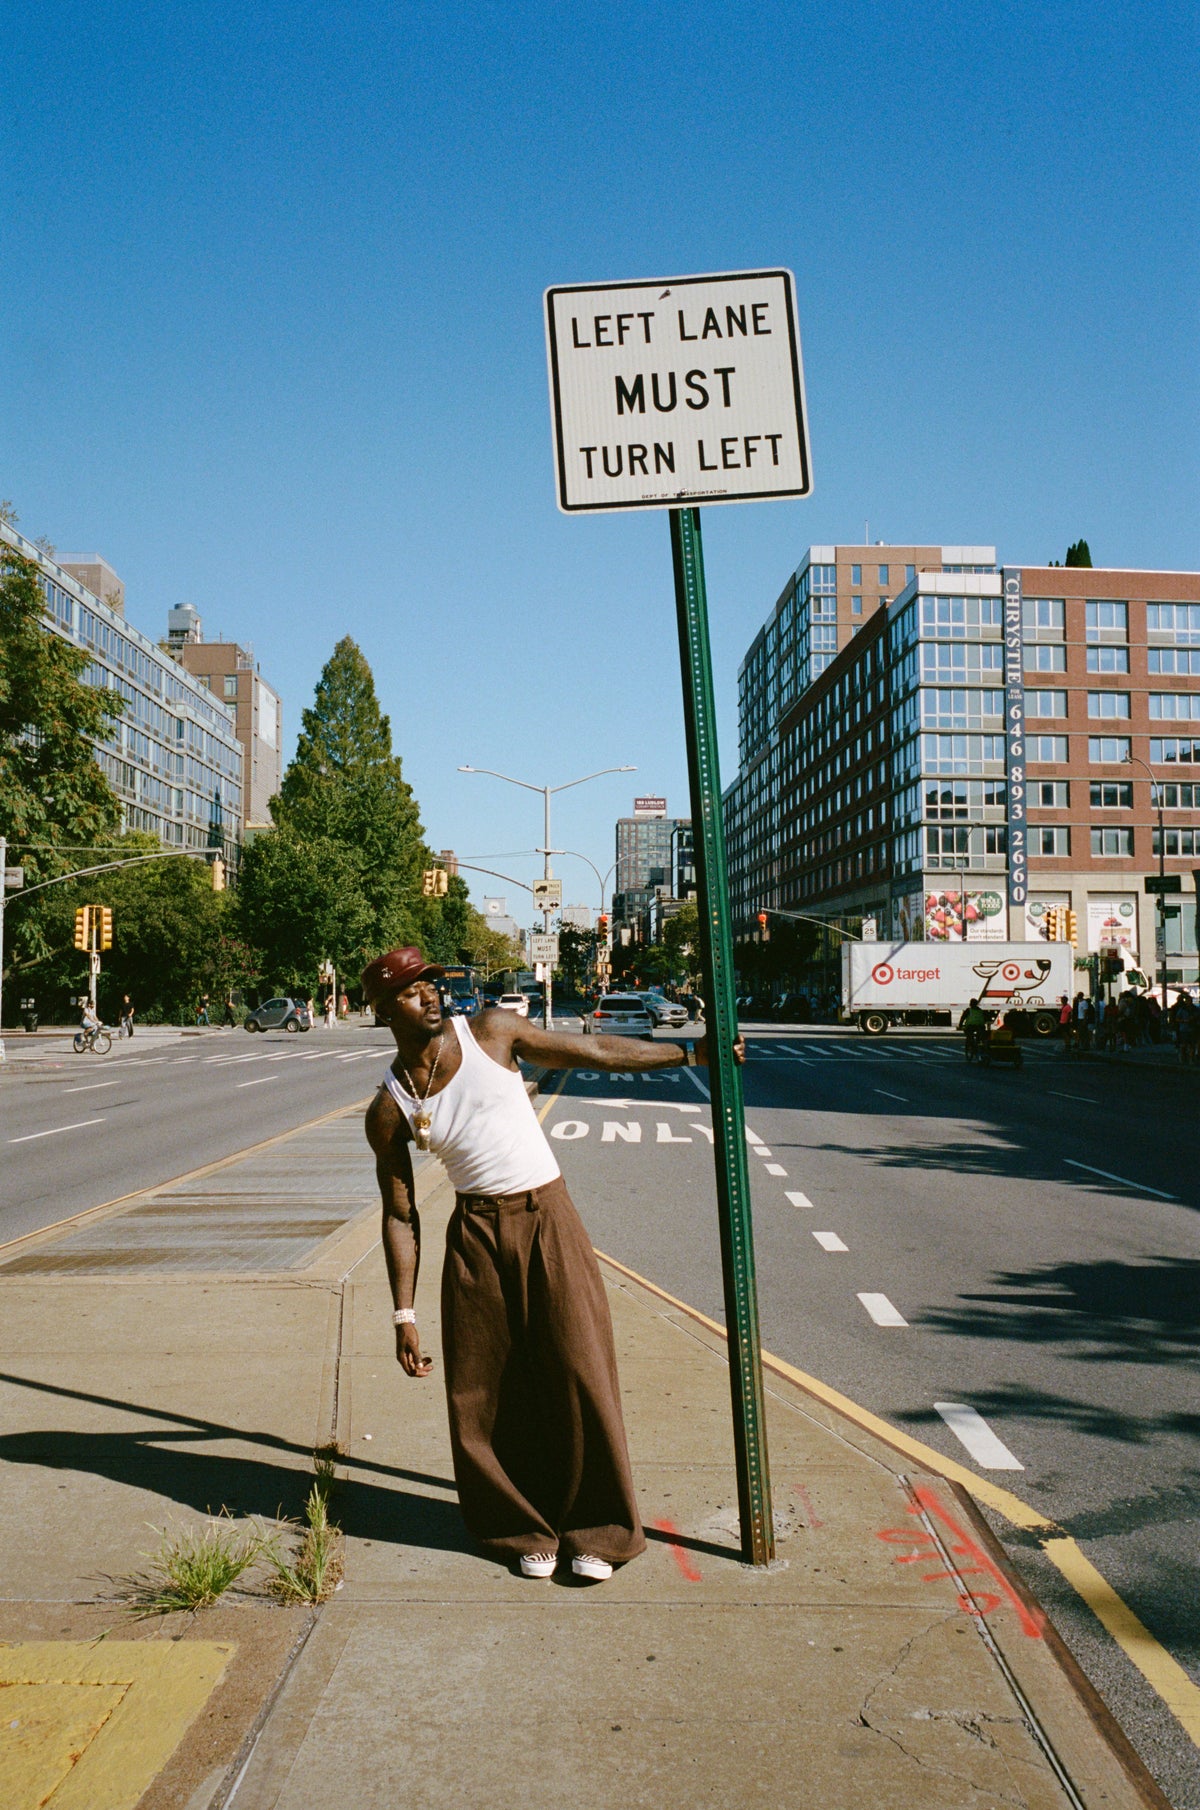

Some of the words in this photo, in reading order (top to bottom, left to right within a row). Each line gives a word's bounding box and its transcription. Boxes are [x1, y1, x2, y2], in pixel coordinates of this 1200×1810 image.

[572, 311, 655, 348] LEFT
[678, 303, 772, 341] LANE
[614, 367, 736, 415] MUST
[579, 442, 676, 479] TURN
[698, 434, 783, 471] LEFT
[1005, 578, 1021, 684] CHRYSTIE
[1010, 704, 1023, 757] 646
[1011, 766, 1024, 820] 893
[1012, 831, 1026, 902] 2660
[864, 927, 875, 935] 25
[896, 967, 941, 983] target
[576, 1072, 680, 1082] ONLY
